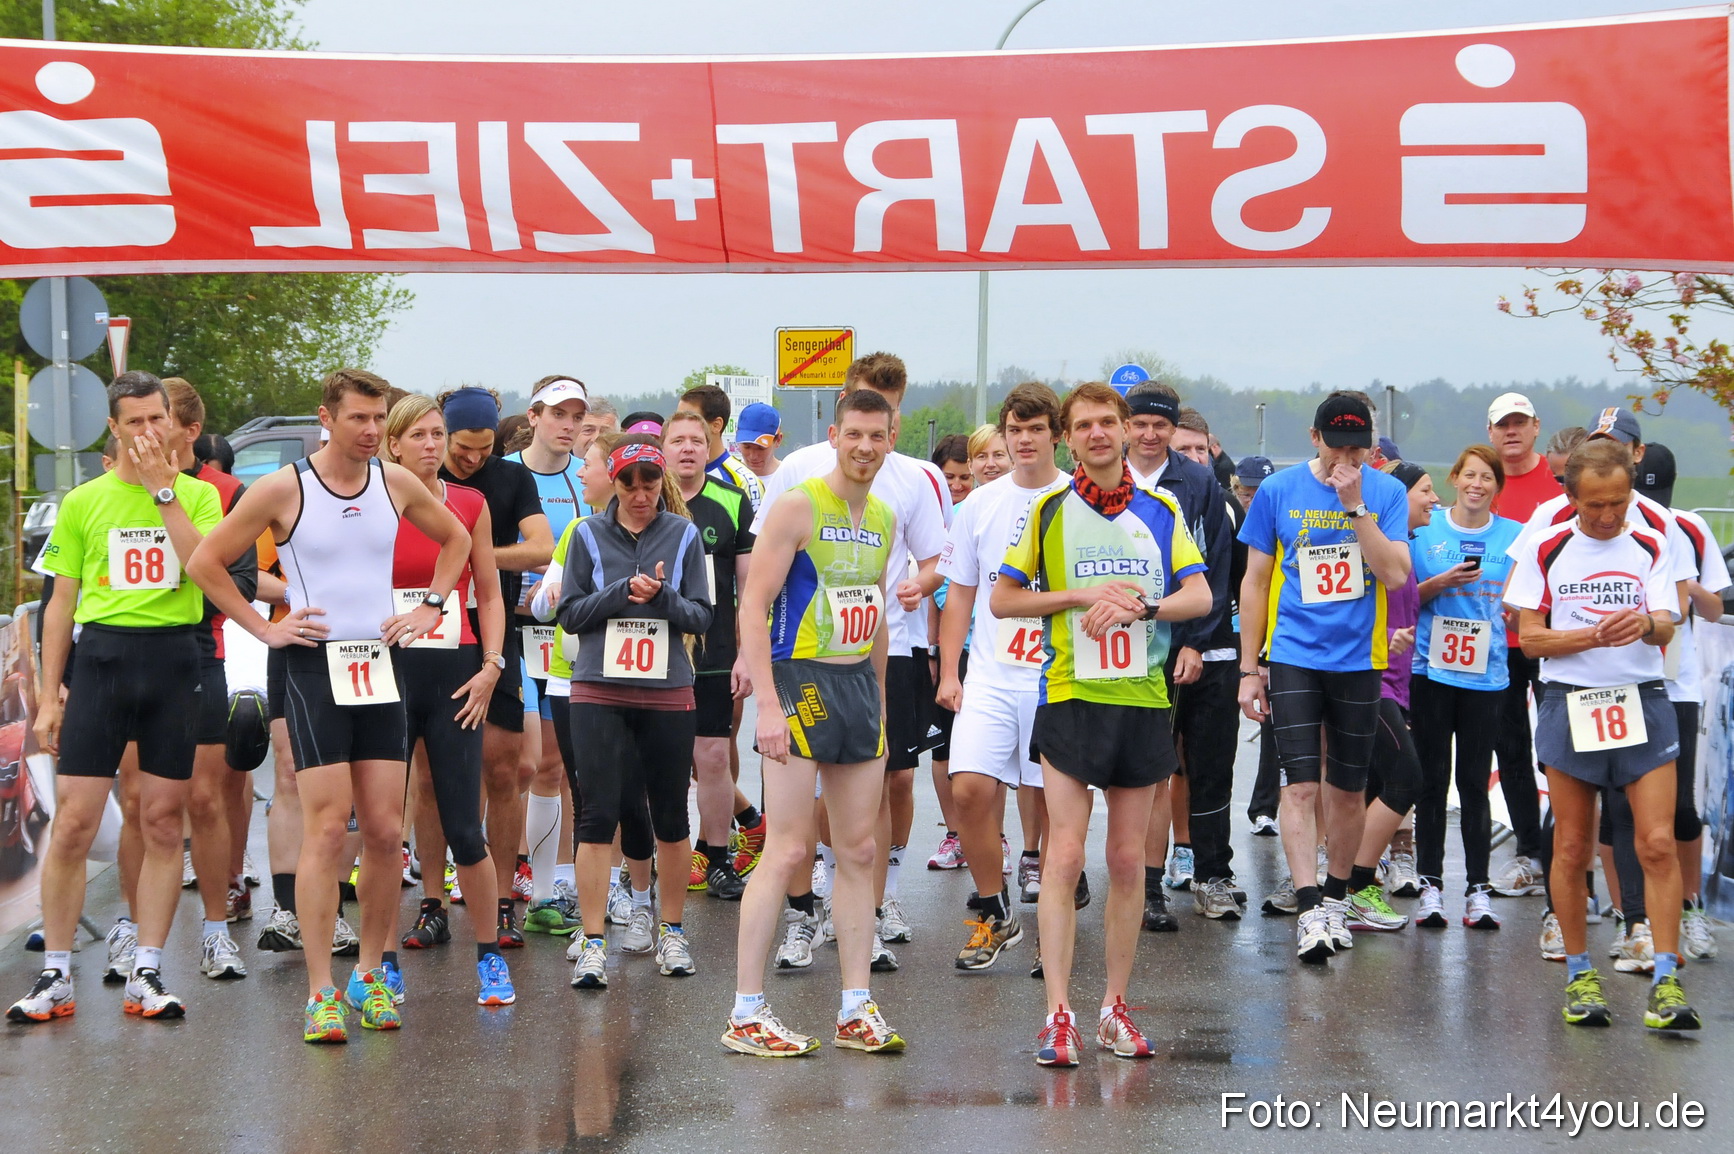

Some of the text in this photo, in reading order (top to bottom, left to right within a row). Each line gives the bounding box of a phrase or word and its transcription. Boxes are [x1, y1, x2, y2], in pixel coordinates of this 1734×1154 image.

[785, 337, 846, 355] Sengenthal
[793, 355, 838, 366] am Anger
[800, 371, 827, 379] Neumarkt
[1288, 509, 1303, 519] 10.
[119, 530, 152, 538] MEYER
[819, 526, 883, 548] BOCK
[1075, 545, 1124, 559] TEAM
[1308, 547, 1337, 556] MEYER
[124, 547, 165, 585] 68
[1074, 558, 1150, 578] BOCK
[1315, 561, 1353, 596] 32
[402, 591, 428, 599] MEYE
[837, 589, 863, 599] MEYER
[1558, 581, 1634, 595] GERHART
[838, 596, 864, 604] WERBUNG
[616, 621, 646, 629] MEYER
[839, 604, 879, 645] 100
[1442, 618, 1470, 628] MEYER
[1570, 610, 1598, 626] Das spo
[1442, 625, 1470, 633] WERBUNG
[339, 644, 370, 653] MEYER
[1007, 627, 1044, 664] 42
[1094, 630, 1131, 669] 10
[1441, 633, 1476, 666] 35
[615, 637, 655, 673] 40
[347, 661, 374, 698] 11
[803, 687, 825, 716] Run!
[1579, 690, 1612, 702] MEYER
[1580, 698, 1614, 707] WERBUNG
[799, 703, 813, 725] Team
[1590, 704, 1628, 743] 18
